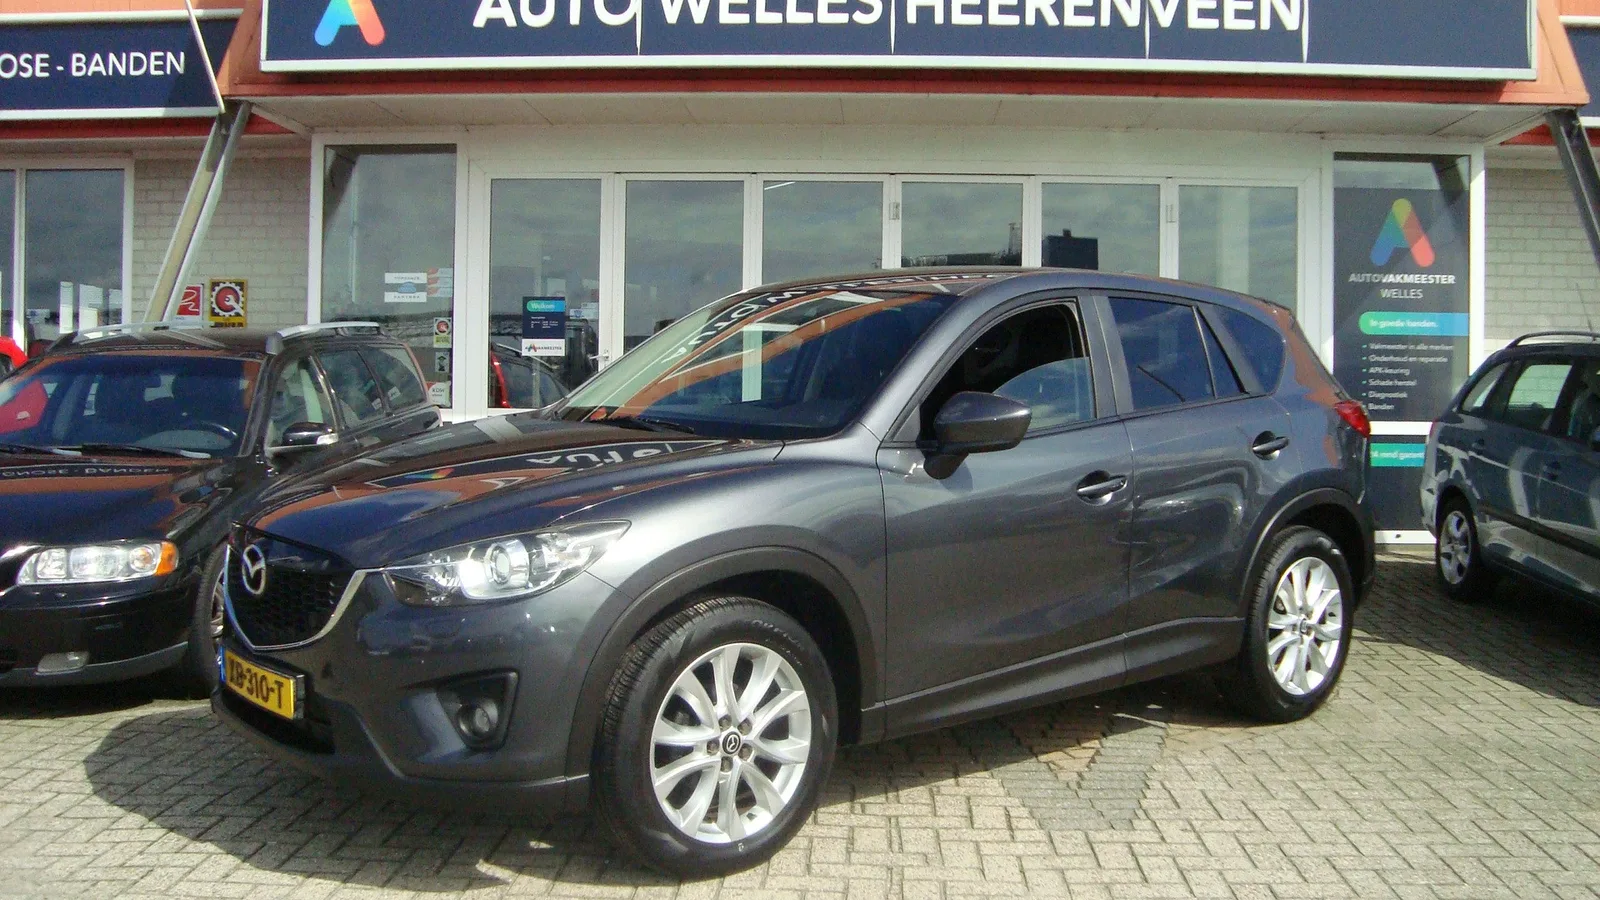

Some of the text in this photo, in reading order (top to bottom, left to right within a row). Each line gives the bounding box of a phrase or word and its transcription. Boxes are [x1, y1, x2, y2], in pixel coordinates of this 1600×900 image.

[473, 0, 1300, 30] AUTO WELLES HEERENVEEN
[71, 51, 185, 77] BANDEN
[1348, 273, 1456, 284] AUTOVAKMEESTER
[1380, 288, 1424, 299] WELLES
[530, 302, 555, 310] Welkom
